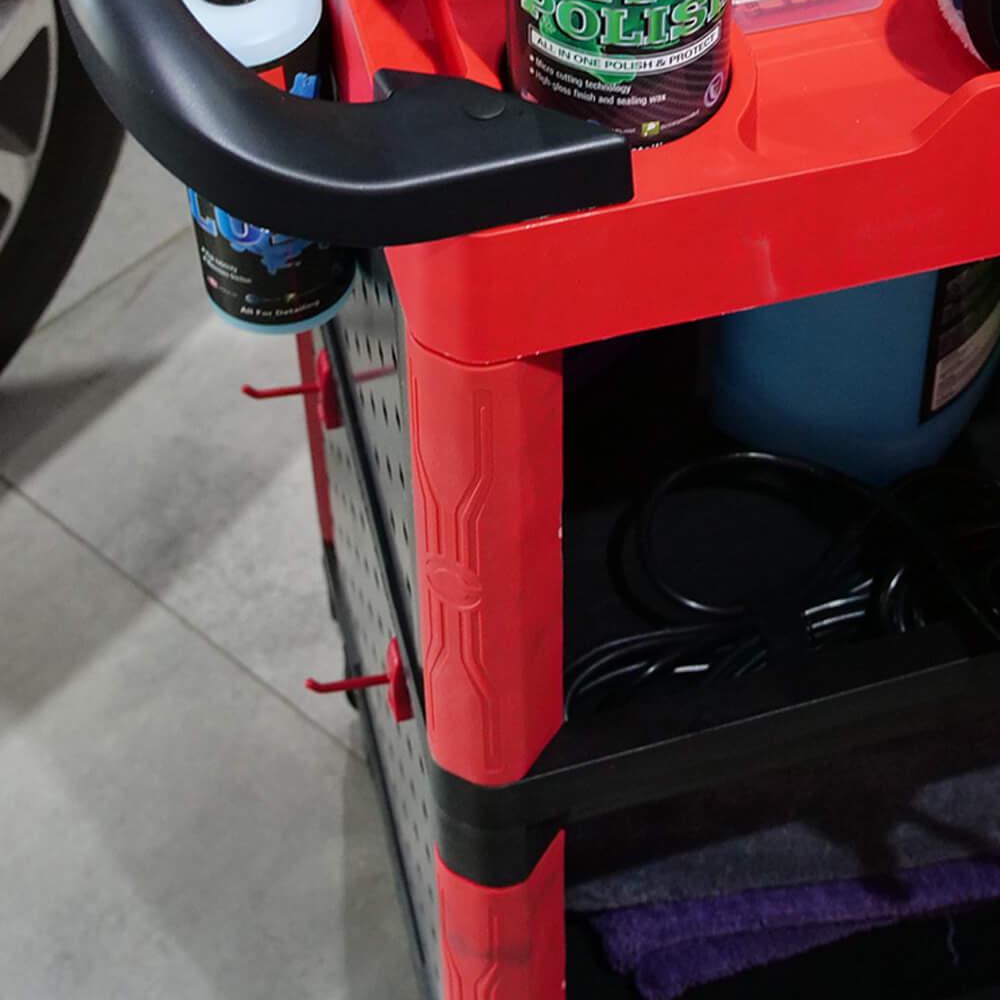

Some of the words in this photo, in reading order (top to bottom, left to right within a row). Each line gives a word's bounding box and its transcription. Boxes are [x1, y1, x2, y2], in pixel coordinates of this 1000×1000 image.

[537, 37, 555, 53] ALL
[558, 48, 571, 60] IN
[574, 54, 598, 67] ONE
[604, 59, 652, 71] POLISH
[655, 58, 666, 68] &
[669, 32, 719, 64] PROTECT
[555, 70, 583, 88] cutting
[585, 79, 632, 95] technology
[598, 95, 615, 105] and
[616, 94, 648, 108] sealing
[648, 93, 667, 105] wax
